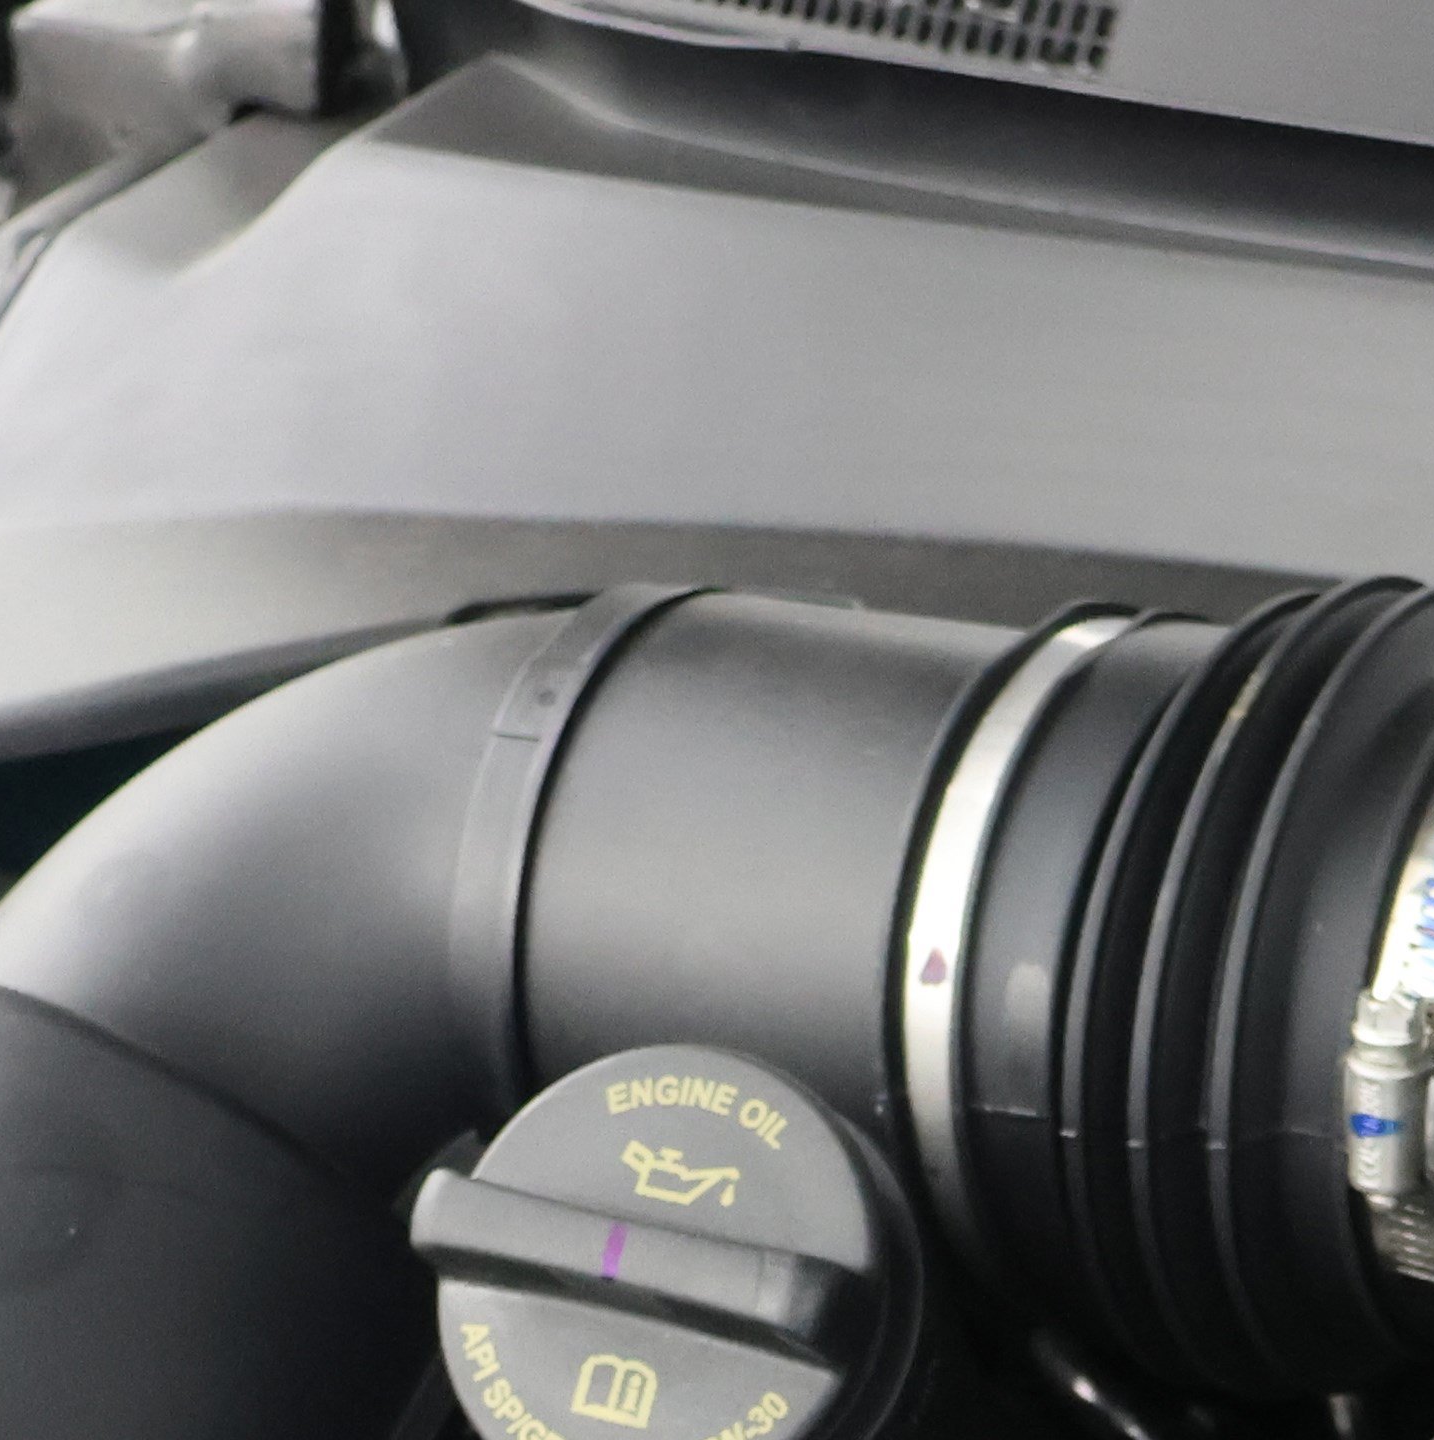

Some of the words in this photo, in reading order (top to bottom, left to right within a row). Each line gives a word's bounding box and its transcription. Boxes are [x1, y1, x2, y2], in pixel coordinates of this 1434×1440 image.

[606, 1075, 738, 1115] ENGINE
[738, 1100, 790, 1149] OIL
[461, 1323, 495, 1382] API
